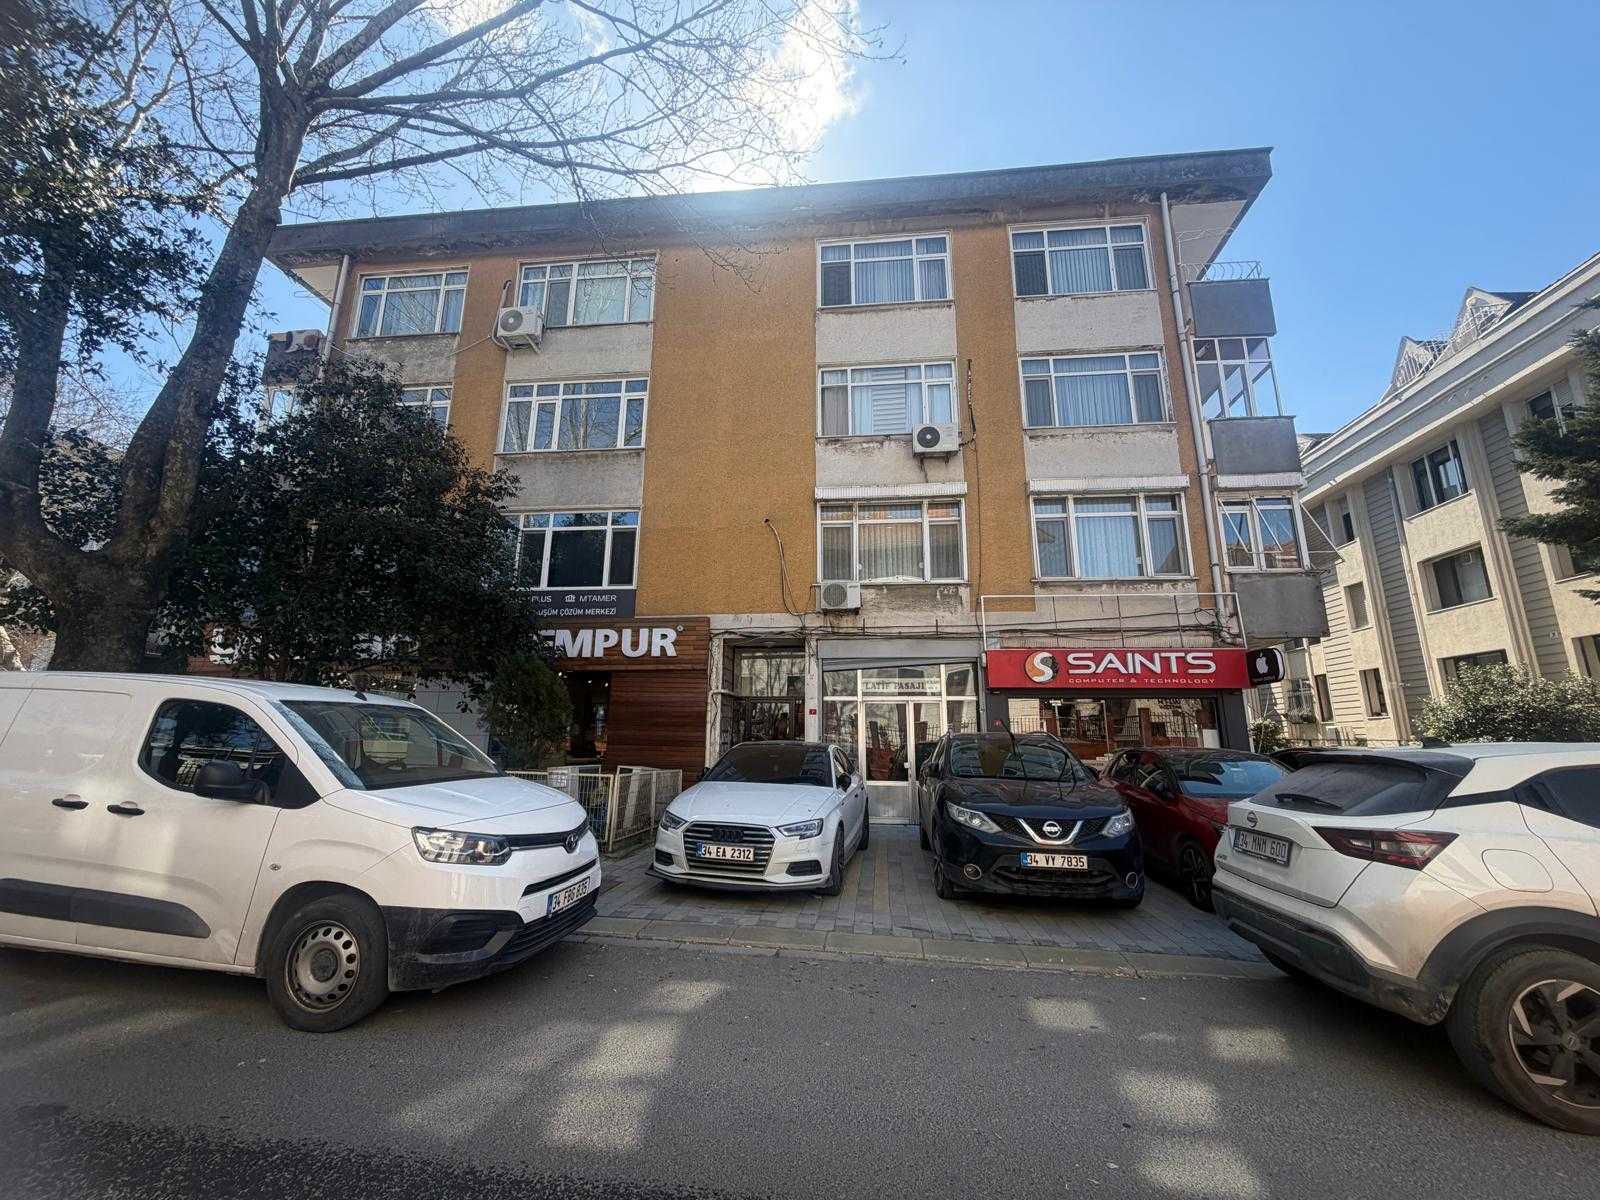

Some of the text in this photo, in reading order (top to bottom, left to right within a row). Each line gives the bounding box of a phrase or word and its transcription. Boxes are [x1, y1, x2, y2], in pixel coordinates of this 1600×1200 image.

[579, 594, 617, 602] MTAMER
[559, 607, 583, 617] ÇÖZÜM
[585, 606, 617, 616] MERKEZİ
[1068, 652, 1216, 674] SAINTS
[1239, 832, 1248, 848] 34
[703, 846, 751, 860] 34 EA 2312
[1027, 854, 1085, 868] 34 VY 7835
